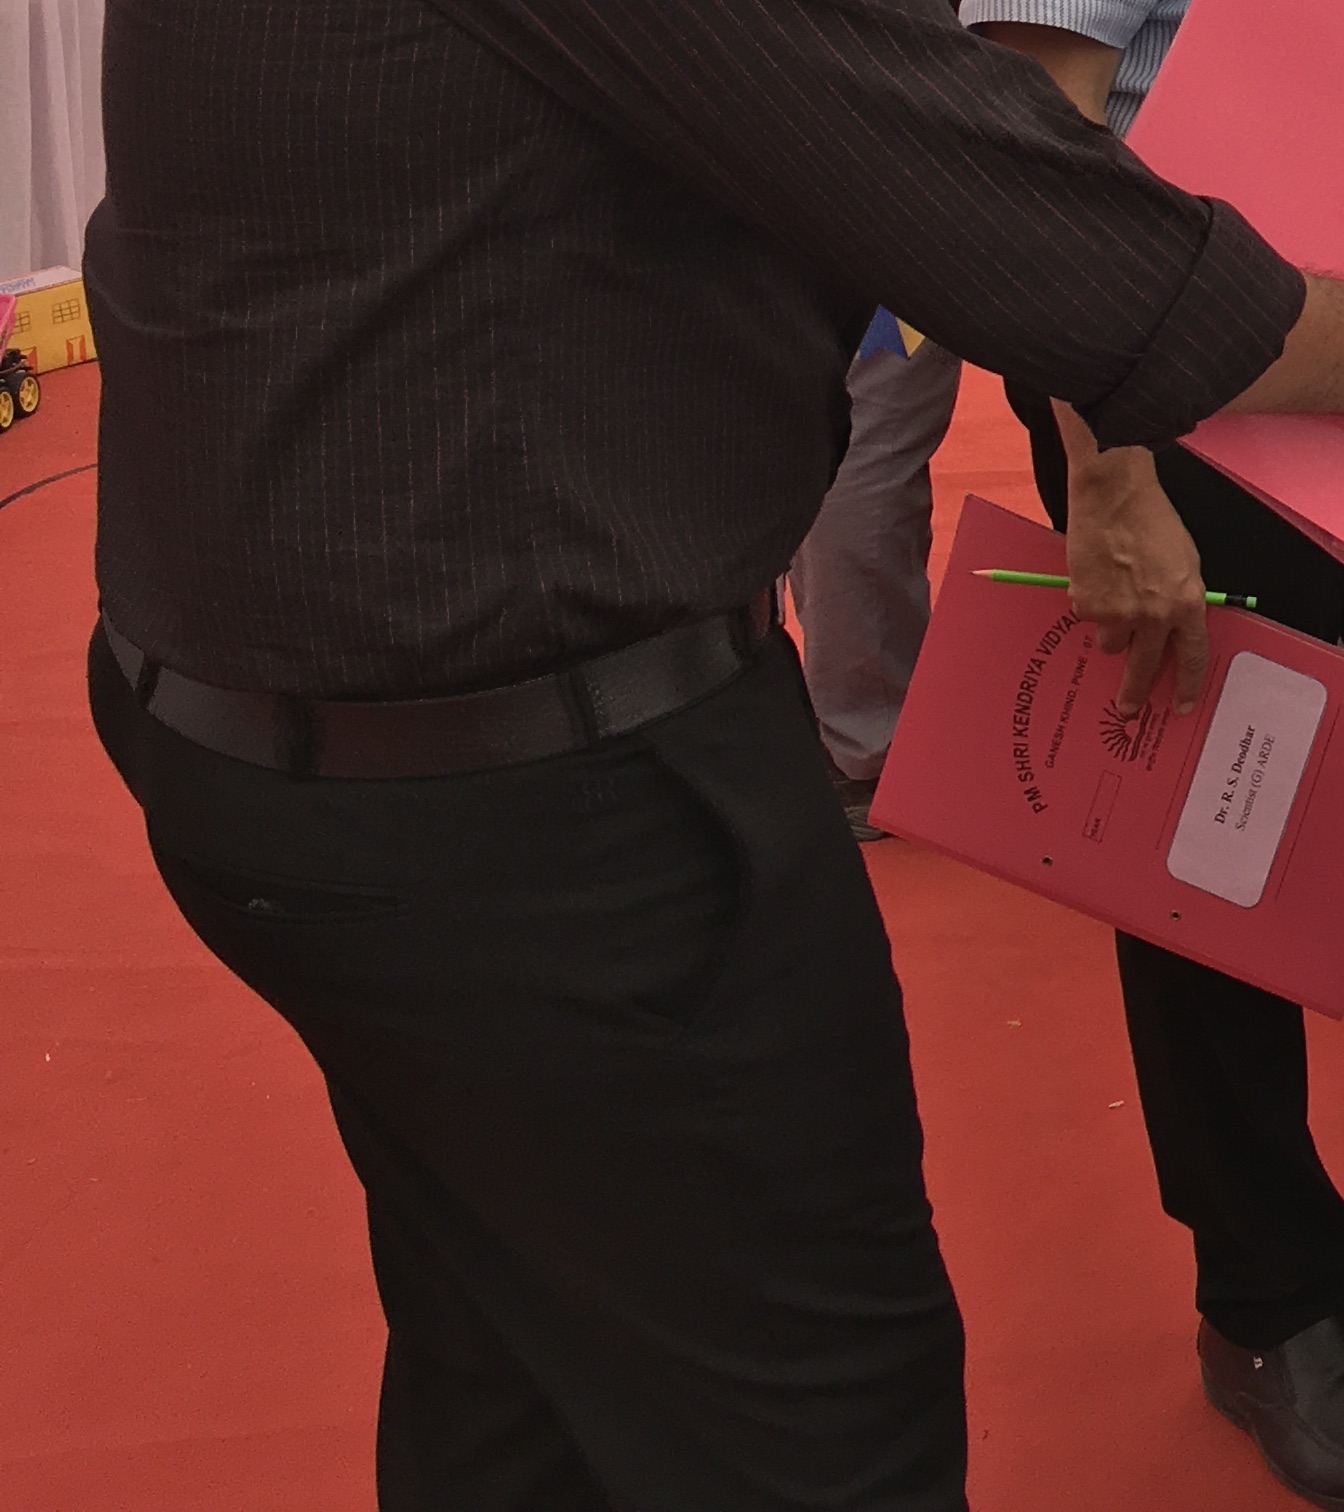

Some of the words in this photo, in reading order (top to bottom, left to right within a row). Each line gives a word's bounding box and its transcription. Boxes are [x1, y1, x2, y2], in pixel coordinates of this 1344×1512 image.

[1013, 655, 1046, 738] KENDRIYA
[1013, 742, 1035, 783] SHRI
[1046, 719, 1065, 769] GANESH
[1232, 724, 1256, 775] Deodhar
[1023, 787, 1048, 814] PM
[1222, 791, 1235, 805] R.
[1235, 787, 1258, 832] Scientist
[1257, 733, 1277, 769] ARDE
[1214, 804, 1231, 825] Dr.
